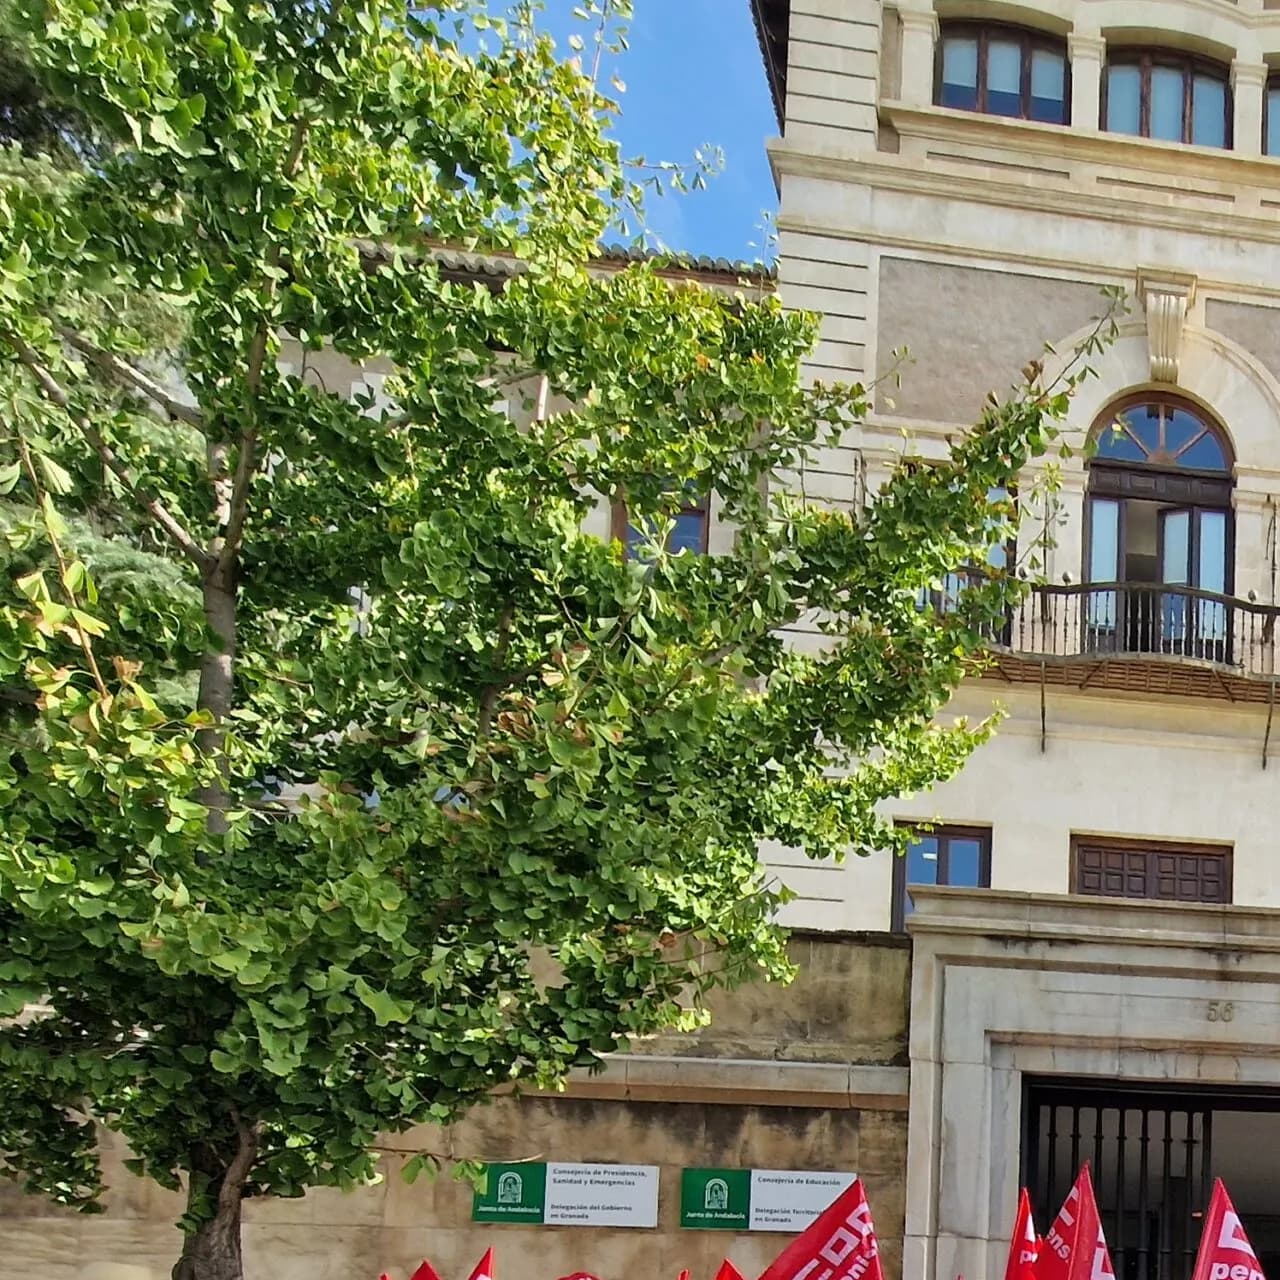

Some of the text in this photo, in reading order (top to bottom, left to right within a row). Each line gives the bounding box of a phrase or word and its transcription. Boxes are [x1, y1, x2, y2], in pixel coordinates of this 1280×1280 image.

[1207, 1001, 1234, 1023] 56
[553, 1168, 590, 1177] Consejería
[590, 1179, 635, 1187] Emergencias
[758, 1177, 794, 1185] Consejería
[806, 1178, 841, 1186] Educación
[551, 1204, 588, 1213] Delegación
[755, 1207, 825, 1216] Delegación Territoria
